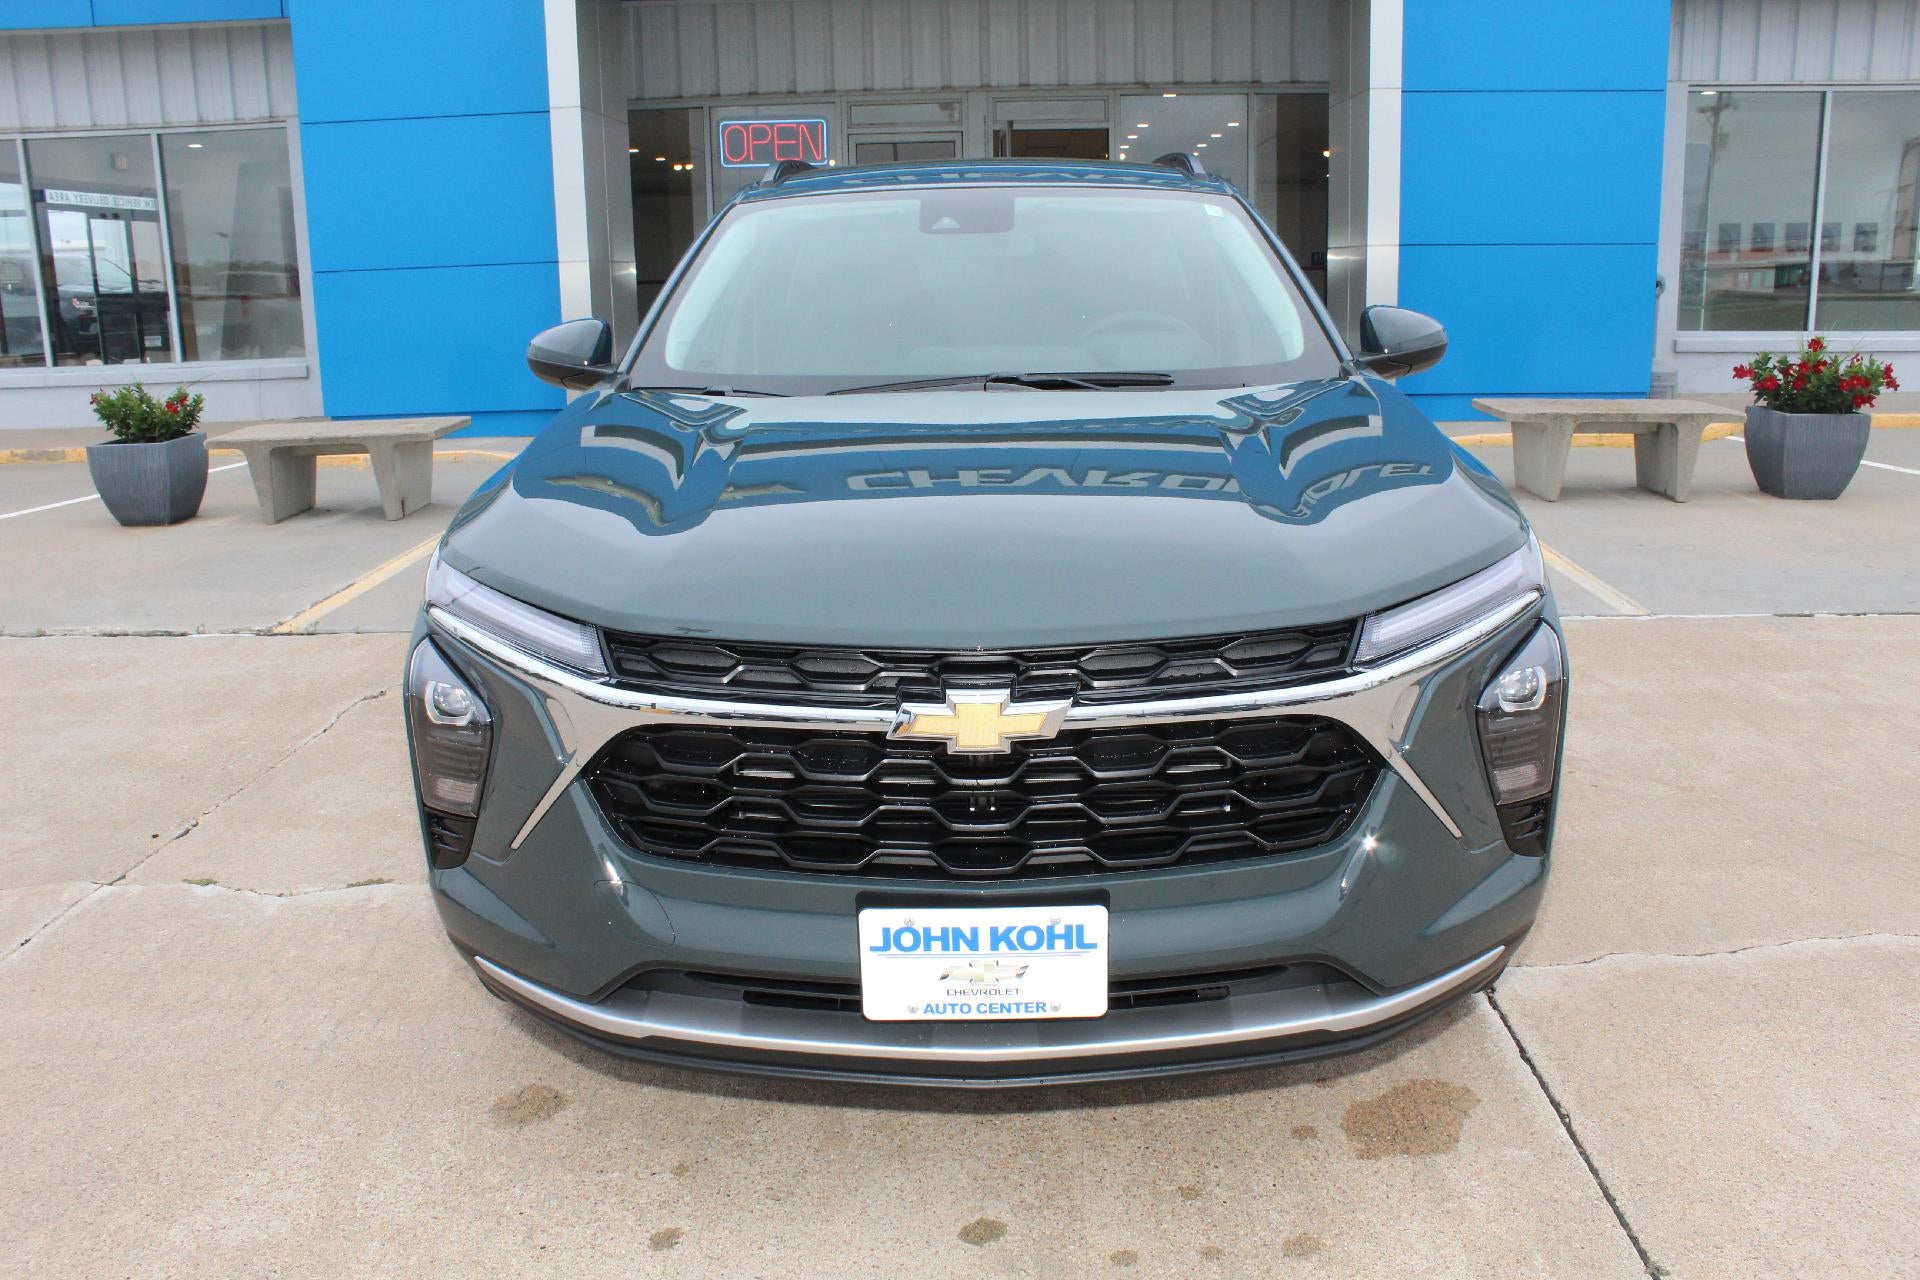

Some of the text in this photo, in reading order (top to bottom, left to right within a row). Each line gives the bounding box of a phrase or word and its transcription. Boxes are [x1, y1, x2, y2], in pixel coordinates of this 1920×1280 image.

[724, 123, 822, 162] OPEN
[870, 924, 1097, 952] JOHN KOHL
[946, 988, 1020, 996] CHEVROLET
[923, 1002, 1047, 1014] AUTO CENTER
